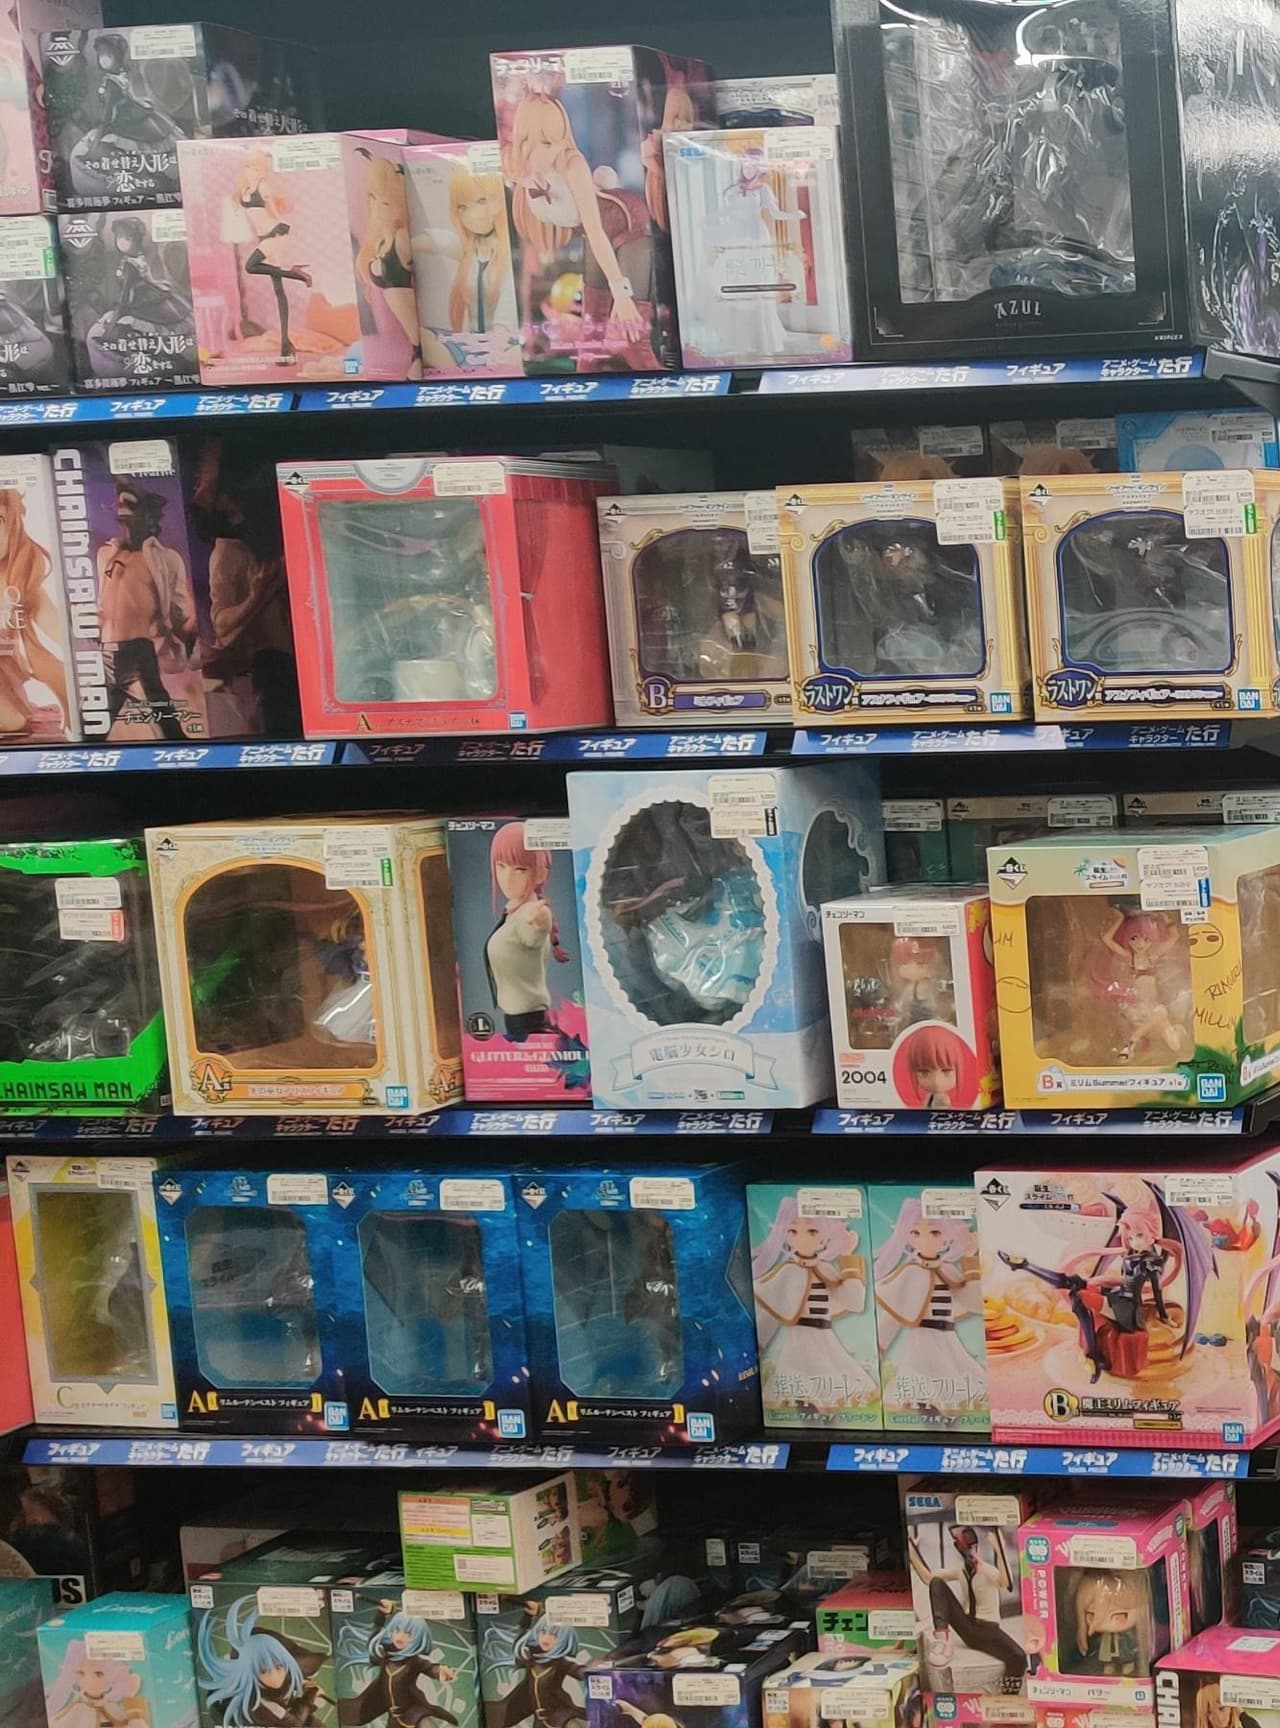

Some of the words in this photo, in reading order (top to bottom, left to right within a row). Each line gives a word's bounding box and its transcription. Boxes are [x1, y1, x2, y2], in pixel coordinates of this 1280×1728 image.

[1006, 362, 1066, 376] フィギュア
[1158, 355, 1193, 374] た行
[470, 385, 505, 402] た行
[540, 381, 598, 395] フィギュア
[110, 399, 167, 413] フィギュア
[247, 392, 283, 409] た行
[54, 448, 100, 639] CHAINSAW
[76, 650, 112, 736] MAN
[648, 684, 666, 708] B
[804, 682, 853, 706] ラストワン
[1047, 677, 1096, 701] ラストワン
[579, 739, 636, 751] フィギュア
[722, 734, 756, 749] た行
[841, 1069, 887, 1084] 2004
[0, 1082, 87, 1099] HAINSAW
[94, 1082, 133, 1099] MAN
[523, 1113, 558, 1129] た行
[838, 1113, 894, 1126] フィギュア
[980, 1111, 1016, 1130] た行
[1051, 1113, 1108, 1127] フィギュア
[187, 1389, 207, 1412] A
[358, 1397, 378, 1420] A
[1054, 1393, 1070, 1415] B
[547, 1399, 567, 1422] A
[992, 1448, 1027, 1468] た行
[1062, 1451, 1119, 1466] フィギュア
[908, 1496, 941, 1508] SEGA
[1037, 1569, 1048, 1618] POWER
